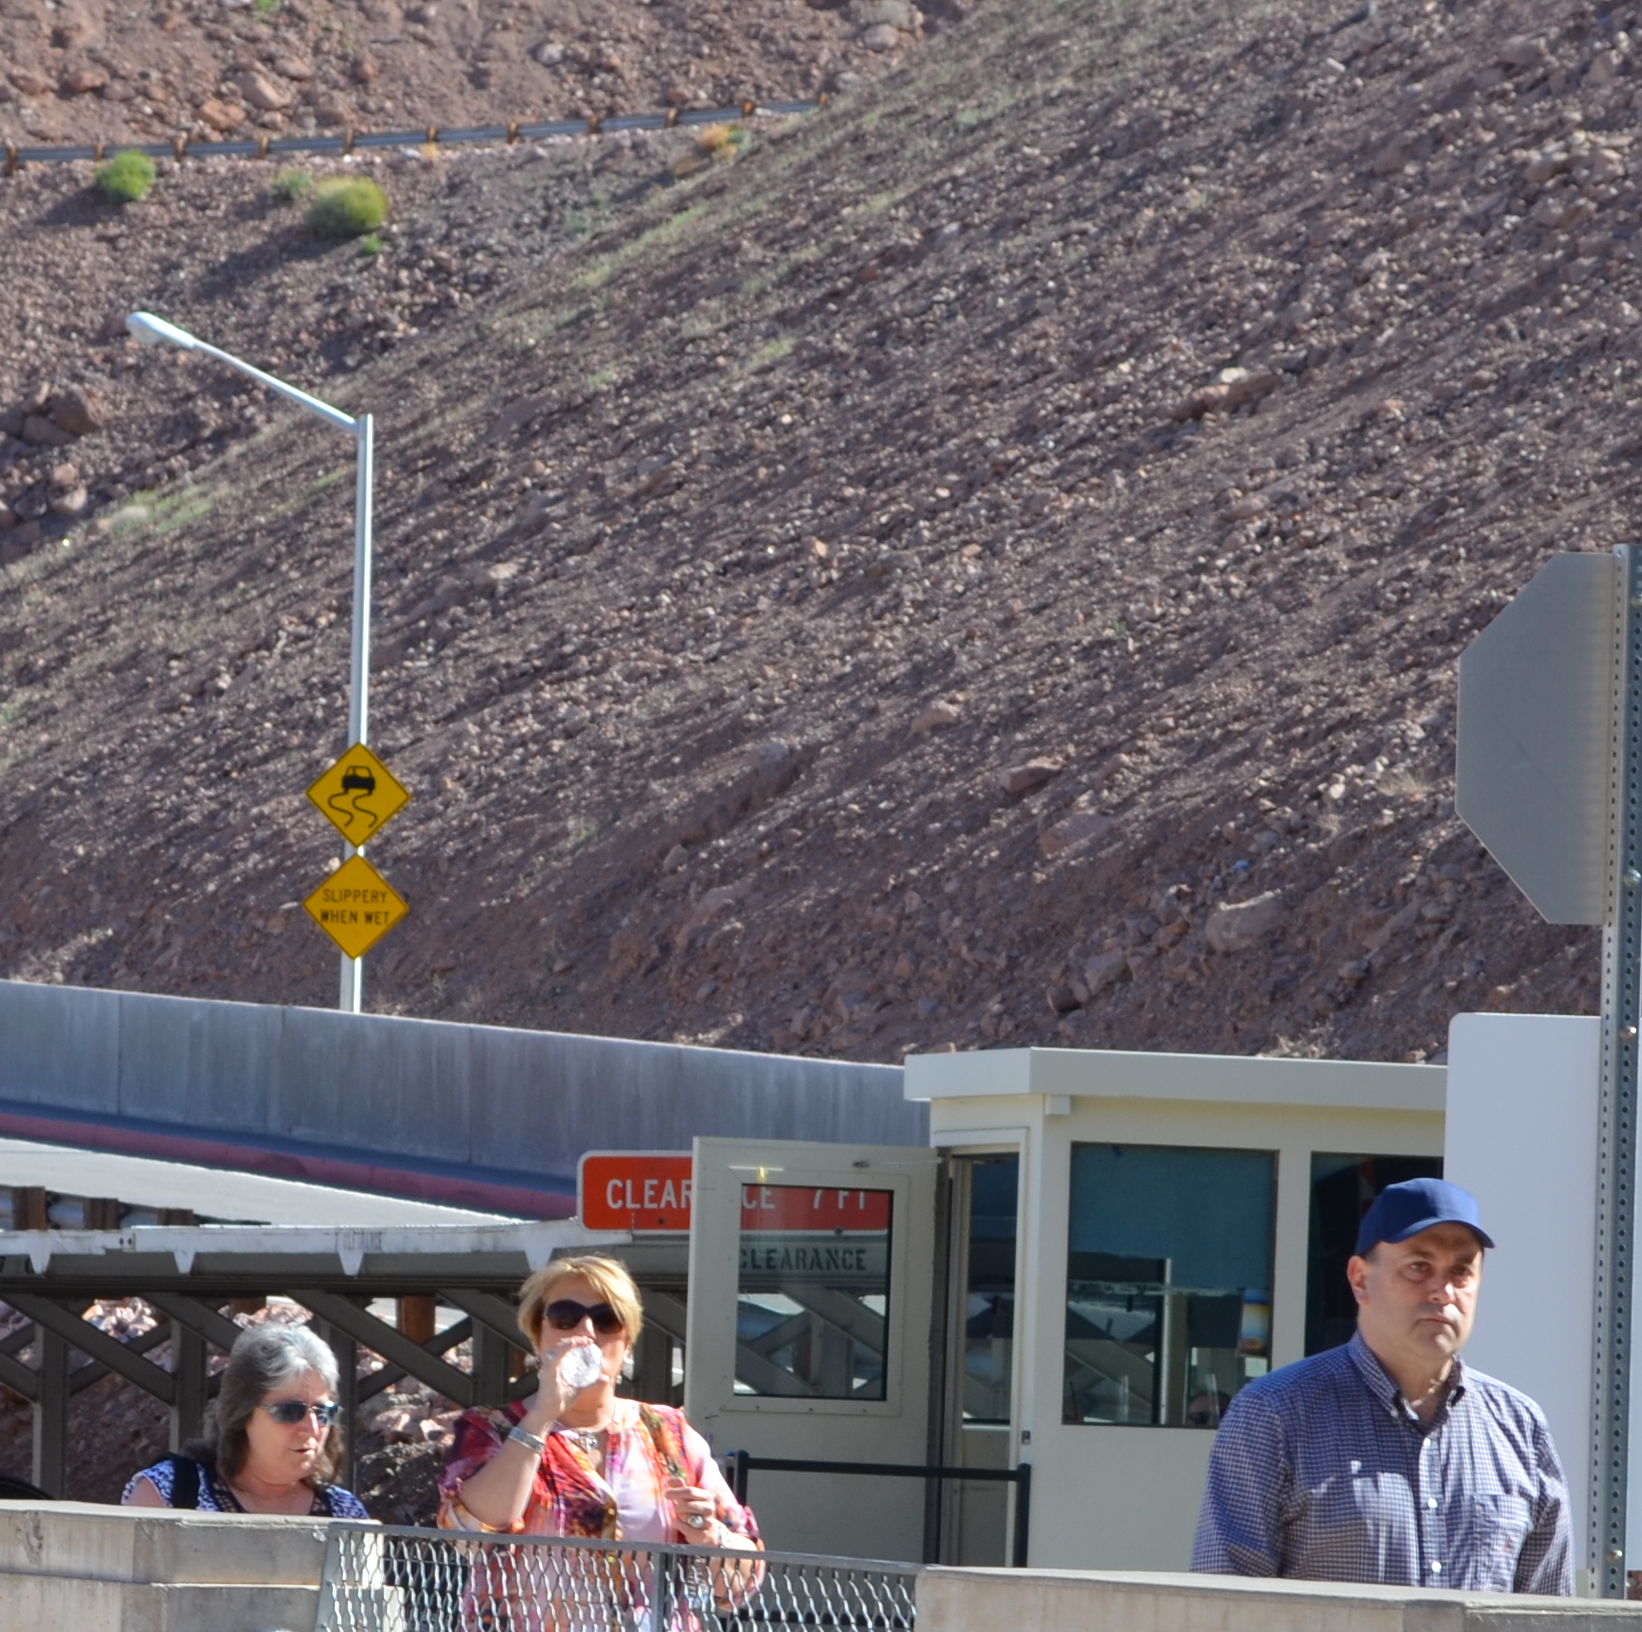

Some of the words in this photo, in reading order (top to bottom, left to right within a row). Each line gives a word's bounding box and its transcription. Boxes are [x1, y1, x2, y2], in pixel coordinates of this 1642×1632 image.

[322, 888, 388, 903] SLIPPERY
[320, 909, 357, 924] WHEN
[363, 911, 389, 925] WET
